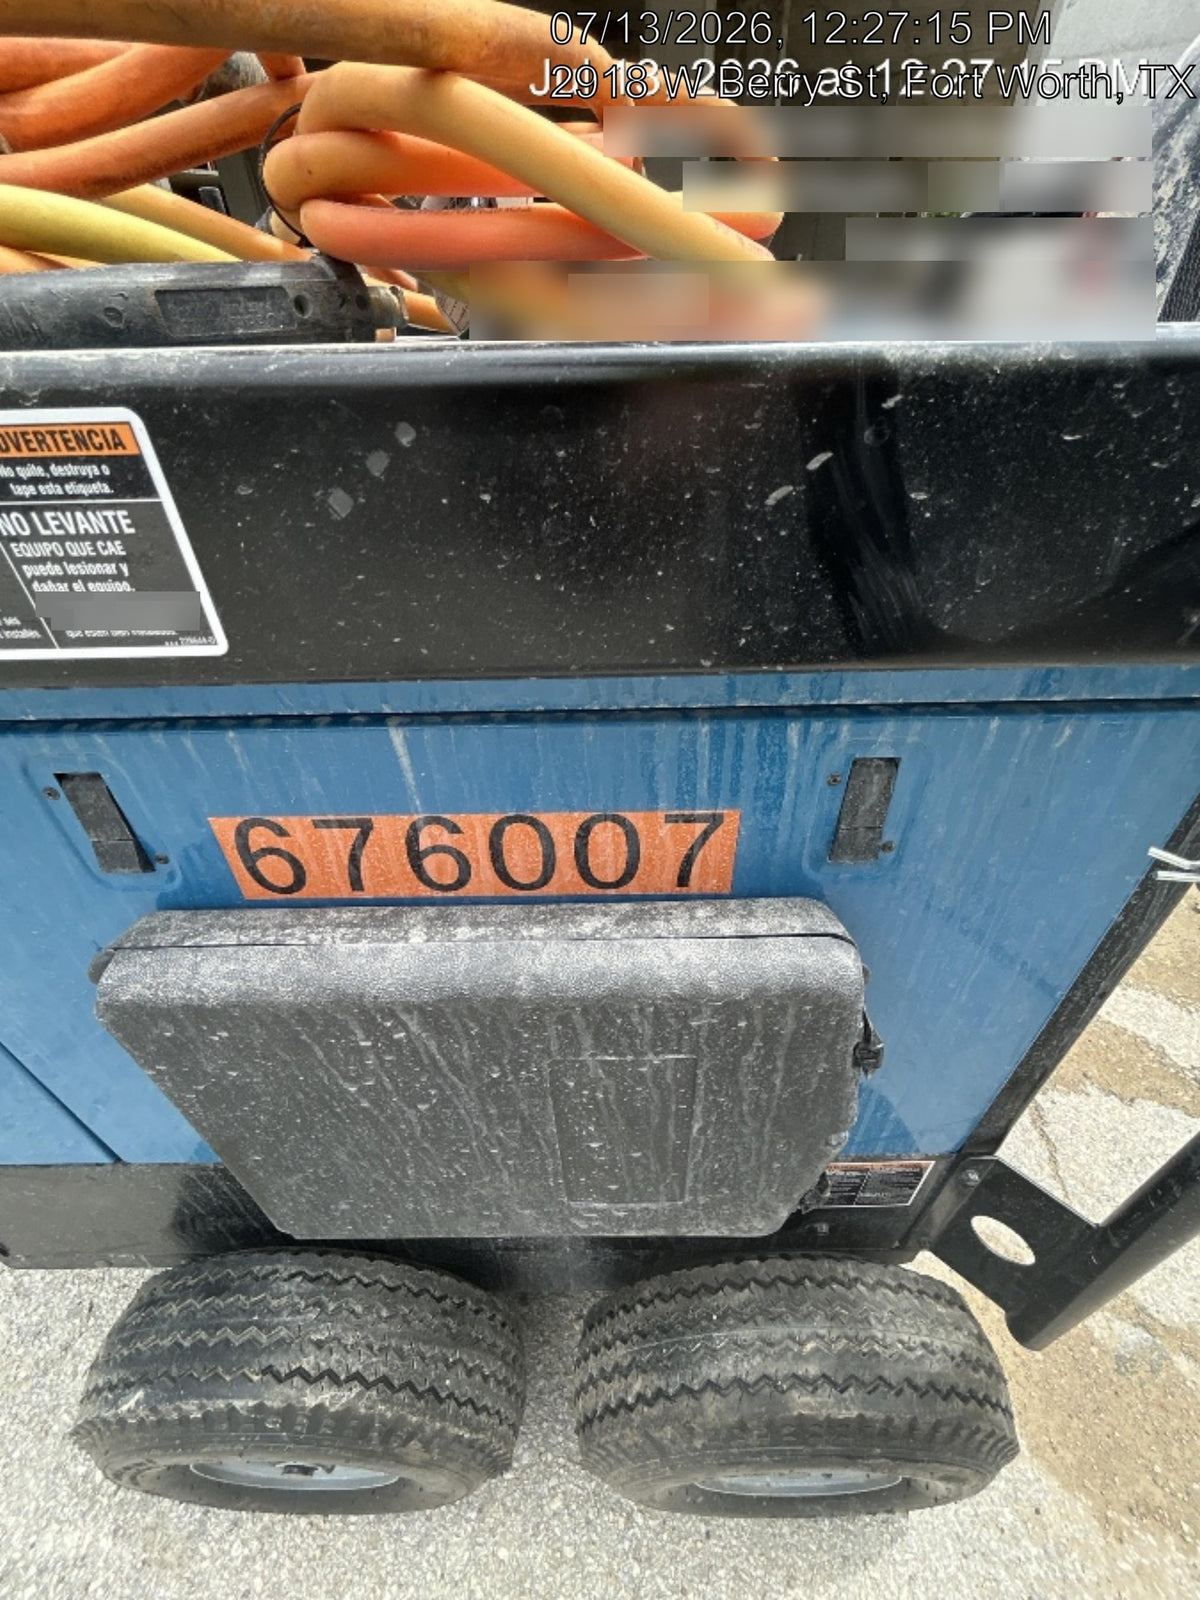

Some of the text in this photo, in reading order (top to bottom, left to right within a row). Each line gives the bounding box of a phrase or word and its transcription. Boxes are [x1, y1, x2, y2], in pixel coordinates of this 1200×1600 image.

[15, 463, 50, 480] quite,
[49, 462, 100, 478] destruya
[101, 464, 110, 475] o
[10, 481, 114, 498] tape esta etiqueta.
[0, 510, 136, 536] NO LEVANTE
[10, 540, 127, 557] EQUIPO QUE CAE
[22, 560, 129, 578] puede lesionar y
[72, 579, 86, 592] el
[234, 813, 725, 894] 676007
